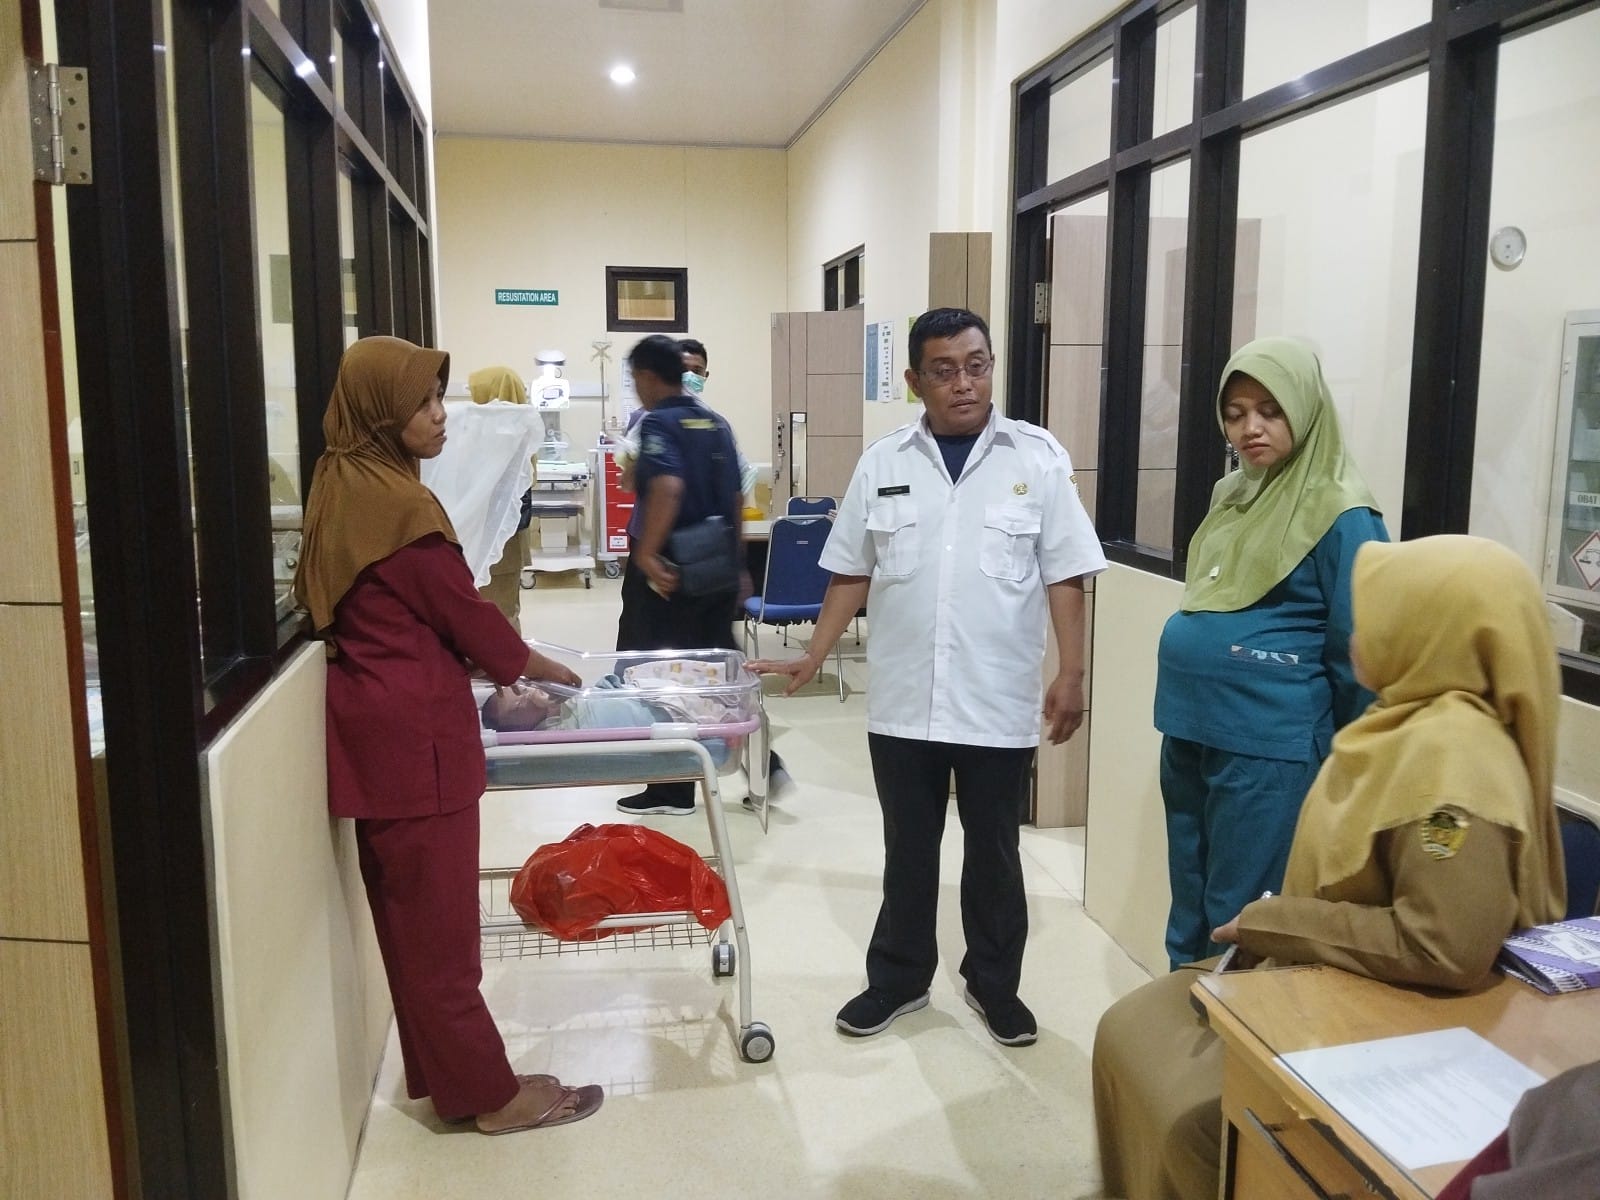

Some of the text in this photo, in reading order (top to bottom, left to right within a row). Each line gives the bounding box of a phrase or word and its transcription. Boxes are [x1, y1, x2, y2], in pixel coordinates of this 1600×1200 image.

[497, 292, 556, 303] RESUSITATION AREA
[1577, 494, 1598, 505] OBAT
